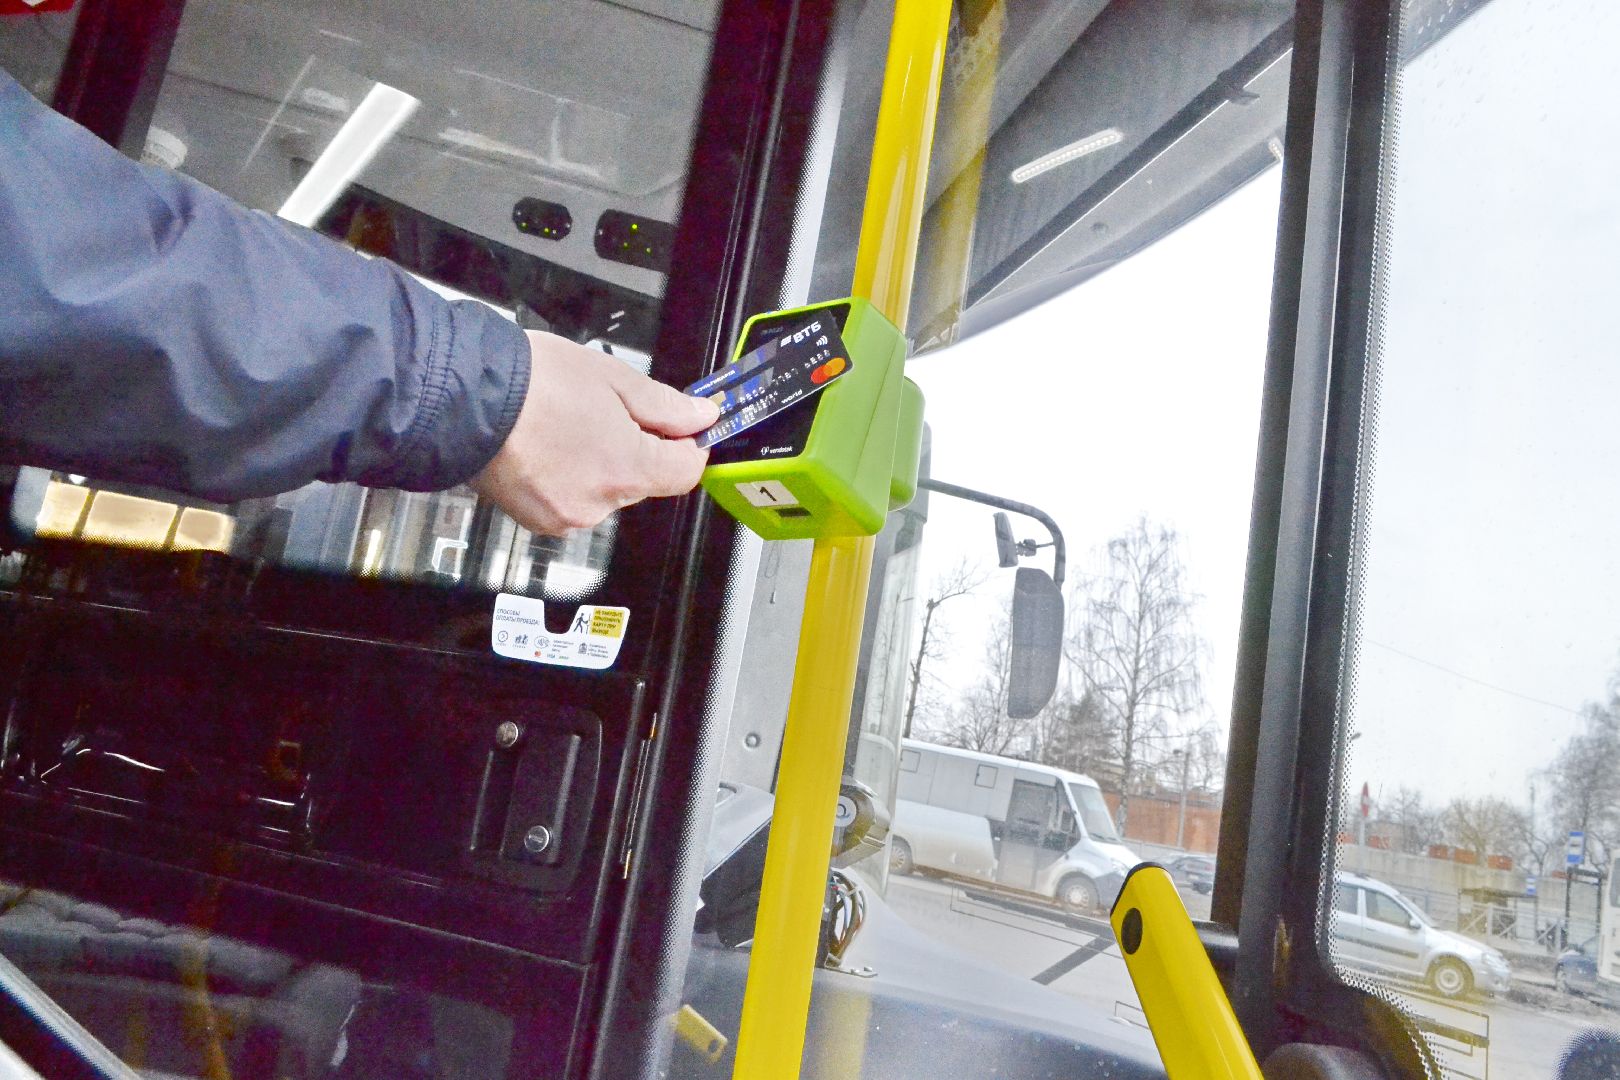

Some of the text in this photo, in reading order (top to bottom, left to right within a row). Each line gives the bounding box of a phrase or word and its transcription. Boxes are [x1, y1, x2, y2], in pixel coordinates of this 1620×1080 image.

[793, 321, 822, 343] ВТБ
[781, 389, 803, 404] world
[759, 486, 777, 502] 1
